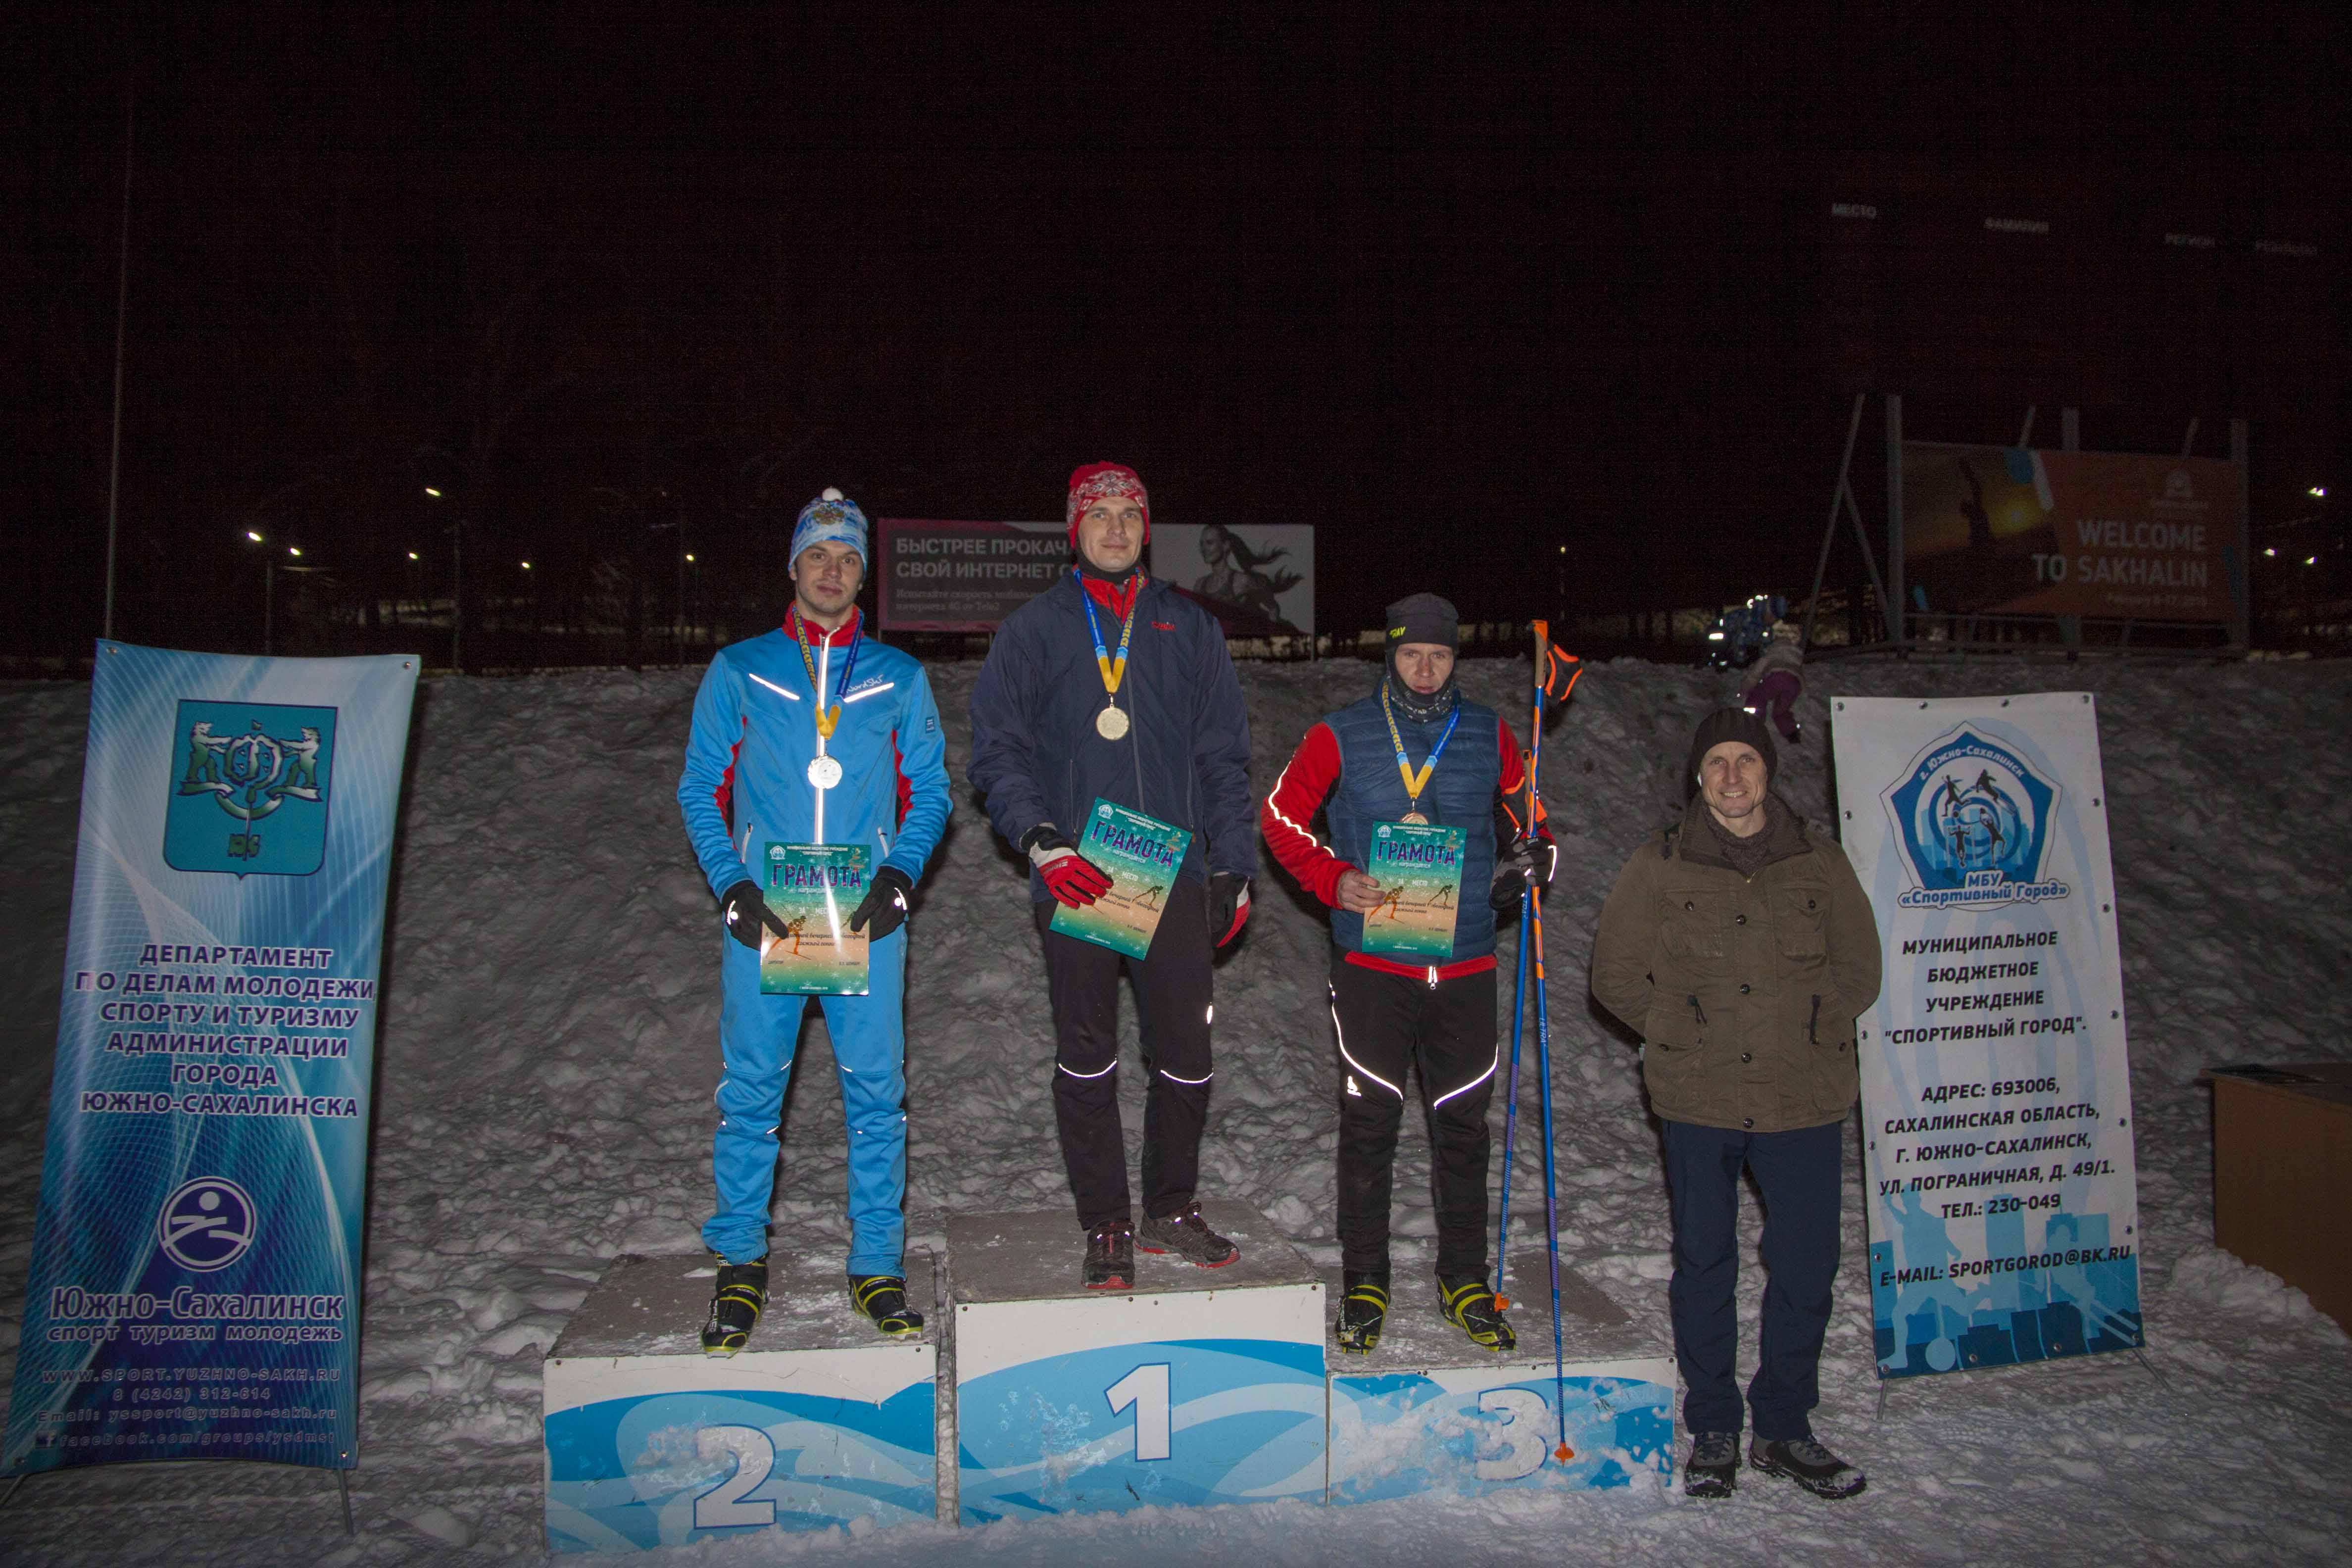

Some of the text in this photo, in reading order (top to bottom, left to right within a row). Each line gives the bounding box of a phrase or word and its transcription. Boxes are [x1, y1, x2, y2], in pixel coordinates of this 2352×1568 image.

[895, 538, 987, 555] БЫСТРЕЕ
[2077, 520, 2207, 553] WELCOME
[895, 559, 951, 579] СВОЙ
[956, 562, 1055, 579] ИНТЕРНЕТ
[2030, 554, 2208, 588] TO SAKHALIN
[1927, 744, 2025, 778] Южно-Сахалинск
[1089, 820, 1176, 868] ГРАМОТА
[1377, 841, 1456, 865] ГРАМОТА
[772, 864, 862, 888] ГРАМОТА
[1967, 872, 2000, 888] МБУ
[1902, 882, 2068, 906] «Спортивный Город»
[139, 944, 333, 968] ДЕПАРТАМЕНТ
[1903, 931, 2058, 955] МУНИЦИПАЛЬНОЕ
[75, 972, 116, 990] ПО
[122, 973, 215, 996] ДЕЛАМ
[1927, 961, 2039, 983] БЮДЖЕТНОЕ
[1926, 990, 2044, 1013] УЧРЕЖДЕНИЕ
[100, 1002, 360, 1029] СПОРТУ И ТУРИЗМУ
[1884, 1015, 2087, 1044] "СПОРТИВНЫЙ ГОРОД".
[105, 1032, 348, 1059] АДМИНИСТРАЦИИ
[172, 1064, 277, 1088] ГОРОДА
[1921, 1077, 2060, 1104] АДРЕС: 693006,
[81, 1092, 358, 1117] ЮЖНО-САХАЛИНСКА
[1884, 1103, 2100, 1135] САХАЛИНСКАЯ ОБЛАСТЬ,
[1896, 1132, 2092, 1164] Г. ЮЖНО-САХАЛИНСК,
[1879, 1159, 2115, 1196] УЛ. ПОГРАНИЧНАЯ, Д. 49/1.
[1941, 1194, 2061, 1219] ТЕЛ.: 230-049
[1880, 1245, 2131, 1287] E-MAIL: SPORTGOROD@BK.RU
[49, 1285, 344, 1321] Южно-Сахалинск
[47, 1325, 343, 1345] спорт туризм молодежь
[112, 1387, 270, 1403] 8 (4242) 312-614
[1104, 1362, 1172, 1462] 1
[1475, 1386, 1548, 1480] 3
[693, 1422, 777, 1529] 2
